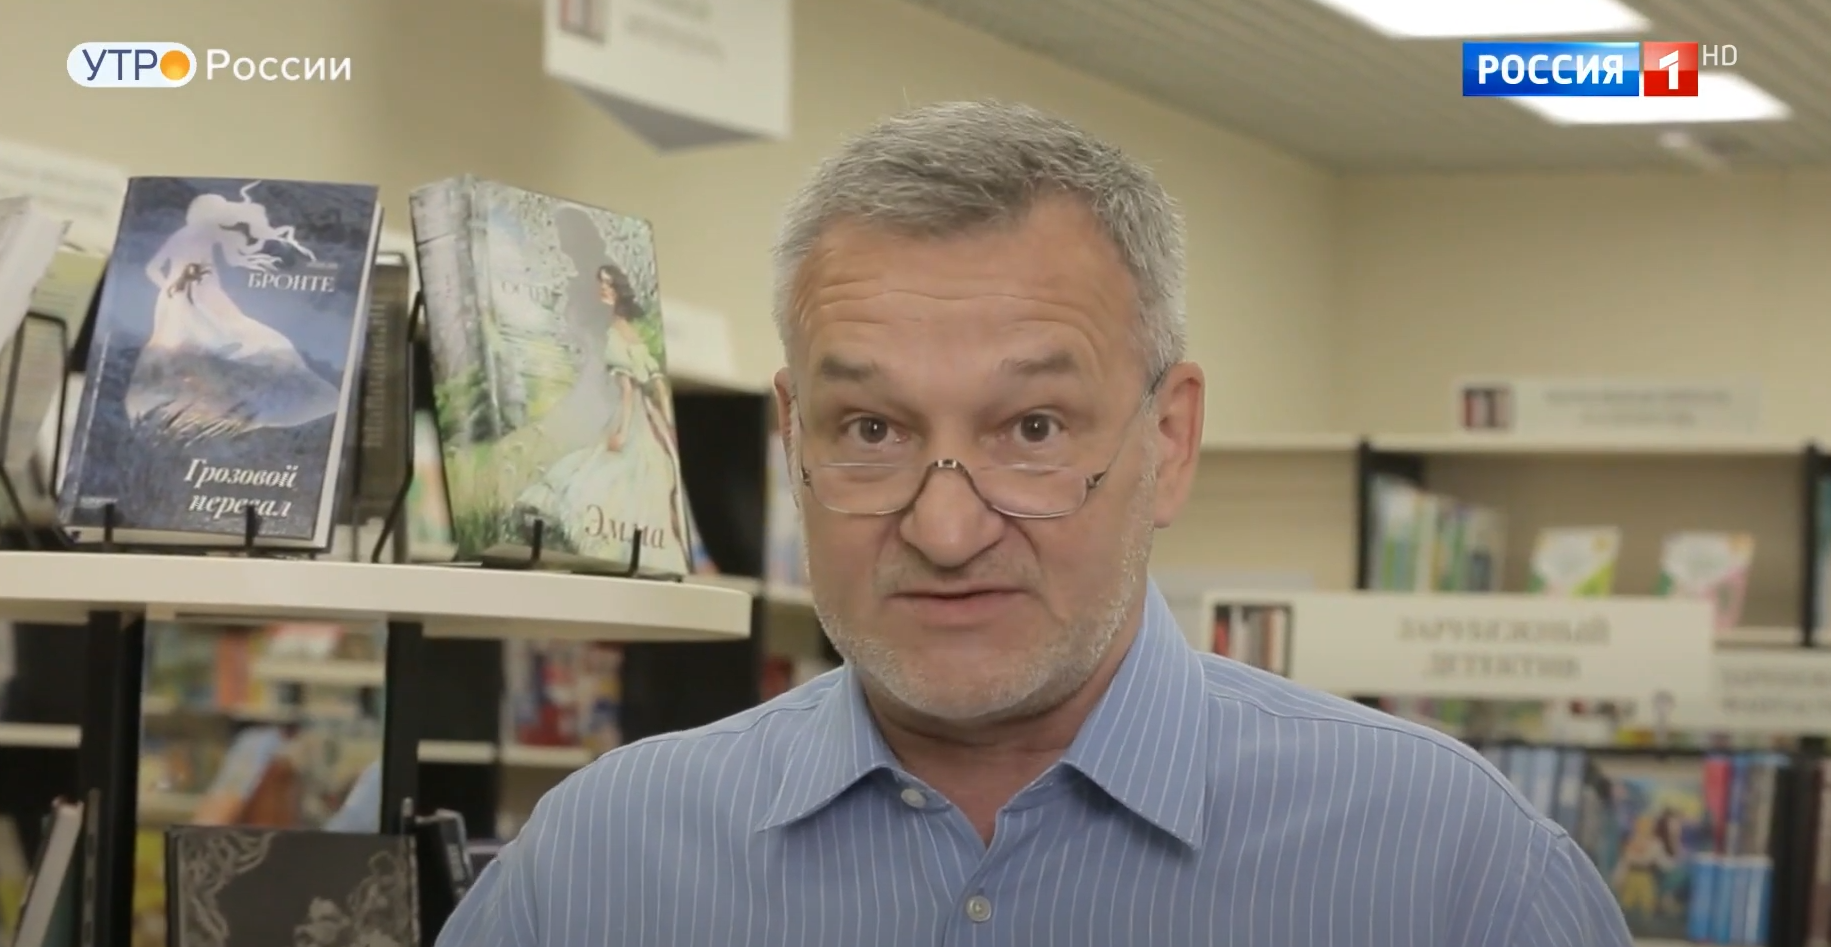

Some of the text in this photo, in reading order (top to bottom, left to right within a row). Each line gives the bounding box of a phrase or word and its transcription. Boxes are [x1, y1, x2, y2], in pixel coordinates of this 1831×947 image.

[248, 272, 335, 293] БРОНТЕ
[183, 457, 299, 489] Грозовой
[1422, 650, 1581, 682] ДЕТЕКТИВ
